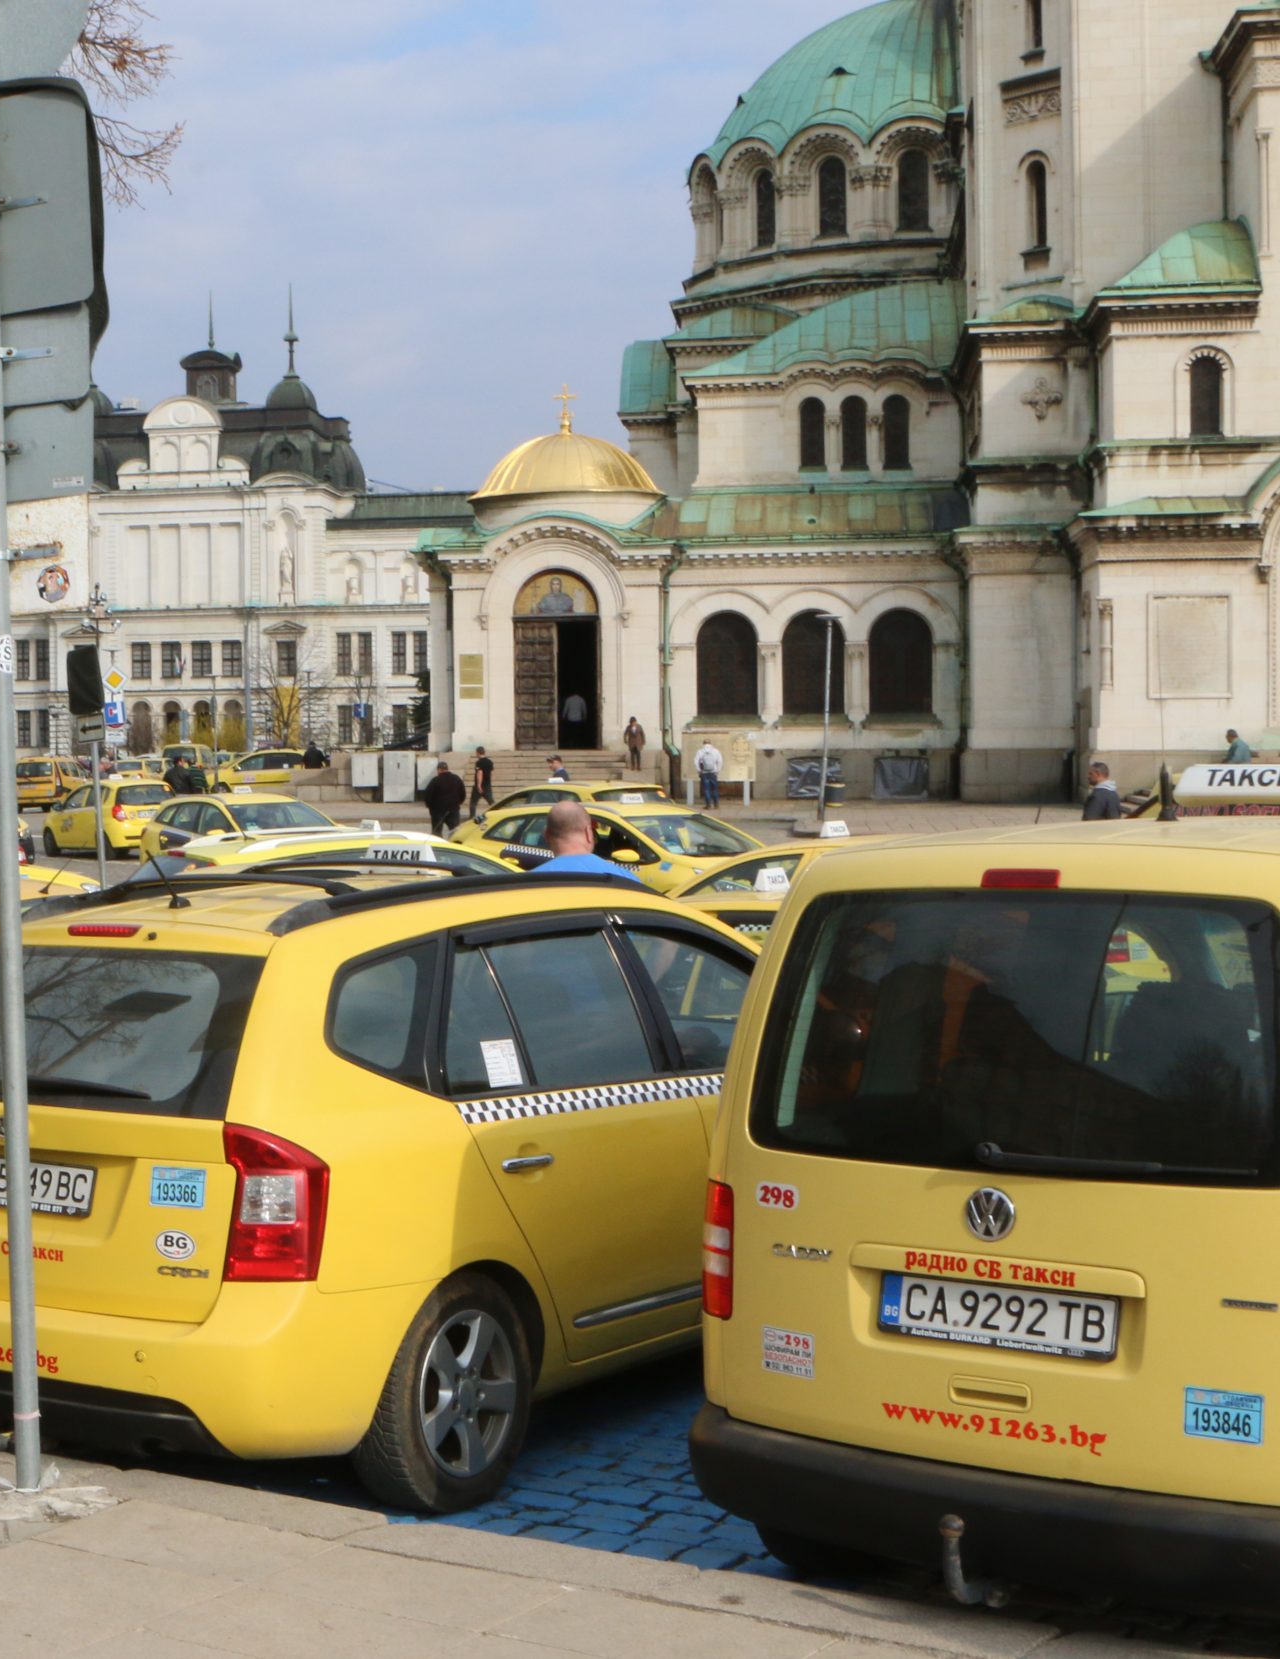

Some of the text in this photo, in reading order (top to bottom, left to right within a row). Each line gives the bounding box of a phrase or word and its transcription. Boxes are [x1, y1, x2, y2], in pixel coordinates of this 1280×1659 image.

[1207, 769, 1280, 787] ТАКС
[372, 850, 420, 860] ТАКСИ
[156, 1183, 197, 1203] 193366
[759, 1185, 794, 1208] 298
[163, 1234, 188, 1250] BG
[32, 1247, 64, 1262] акси
[904, 1250, 1076, 1288] радио СБ такси
[883, 1304, 899, 1317] BG
[959, 1290, 1048, 1337] 9292
[784, 1334, 810, 1350] 298
[911, 1327, 948, 1340] Autohaus
[882, 1402, 1107, 1456] www.91263.bg
[1193, 1407, 1252, 1437] 193846
